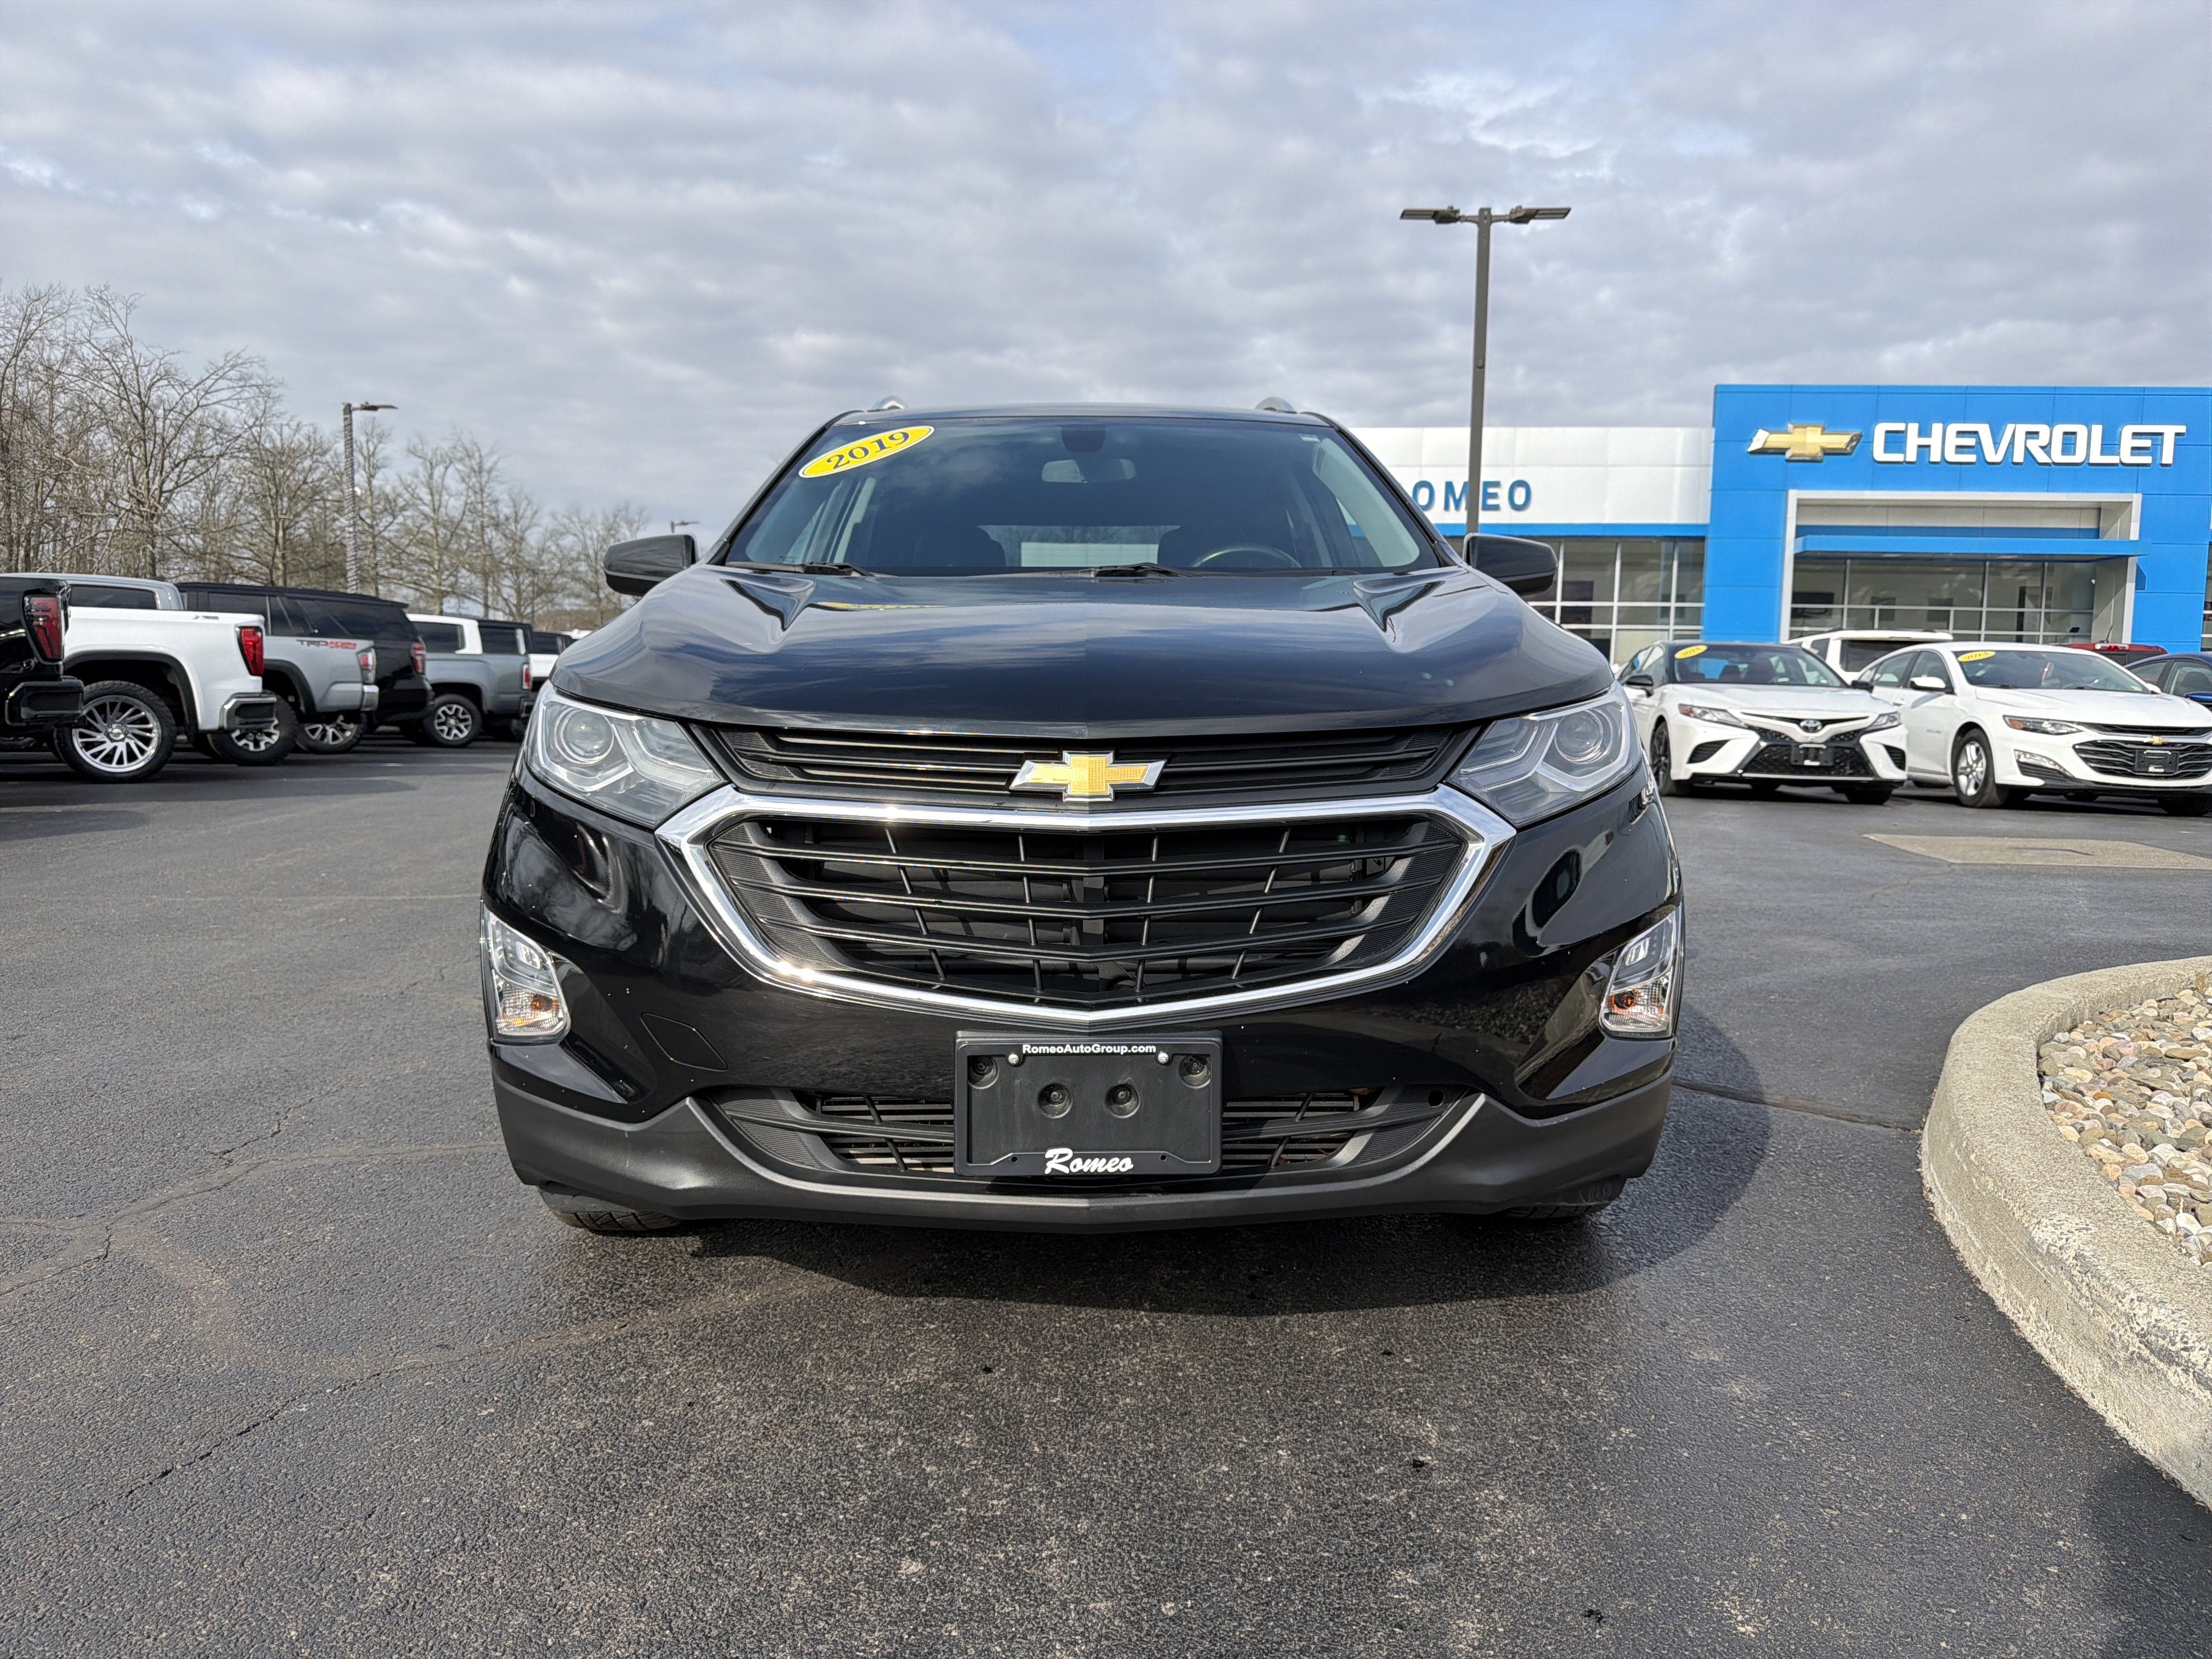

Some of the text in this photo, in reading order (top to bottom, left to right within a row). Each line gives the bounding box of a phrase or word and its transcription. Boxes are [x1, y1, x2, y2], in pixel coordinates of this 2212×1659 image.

[826, 431, 910, 470] 2019
[1872, 422, 2187, 466] CHEVROLET
[1412, 479, 1532, 511] OMEO
[1022, 1044, 1156, 1054] RomeoAutoGroup.com
[1044, 1148, 1134, 1175] Romeo
